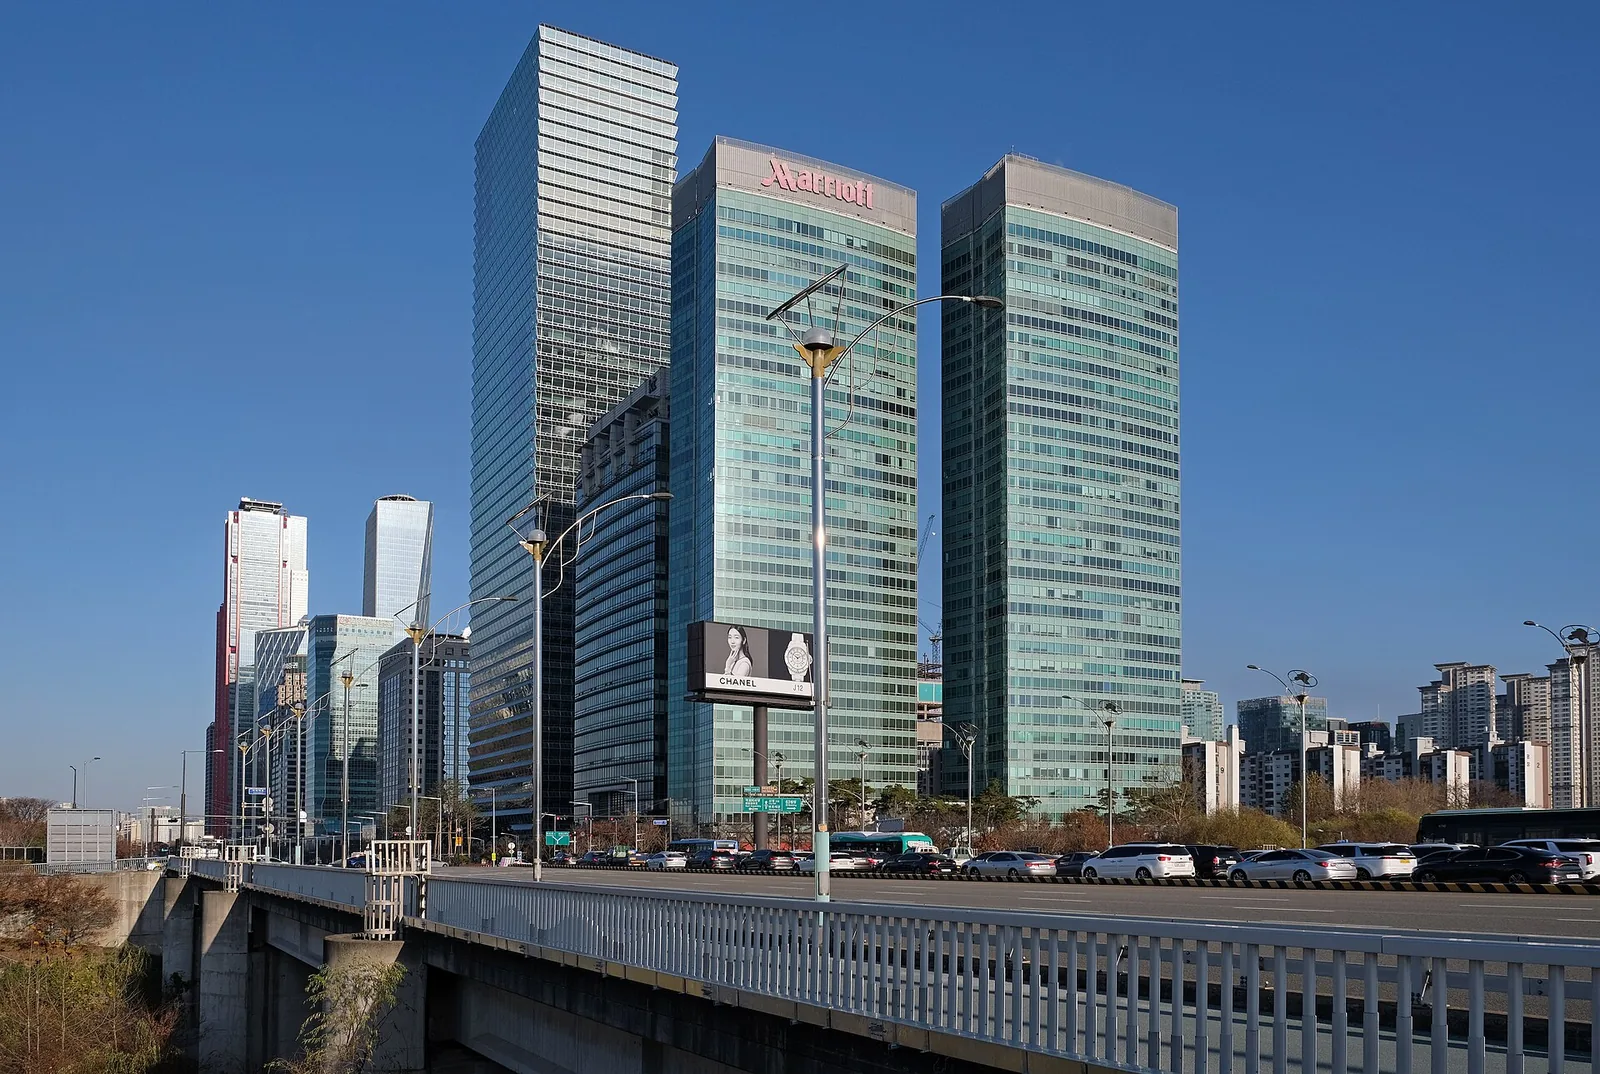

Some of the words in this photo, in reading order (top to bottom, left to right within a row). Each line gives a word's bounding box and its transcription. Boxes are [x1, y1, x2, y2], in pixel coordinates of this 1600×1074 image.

[761, 158, 874, 209] Marriott
[719, 677, 757, 688] CHANEL
[793, 684, 804, 692] J12
